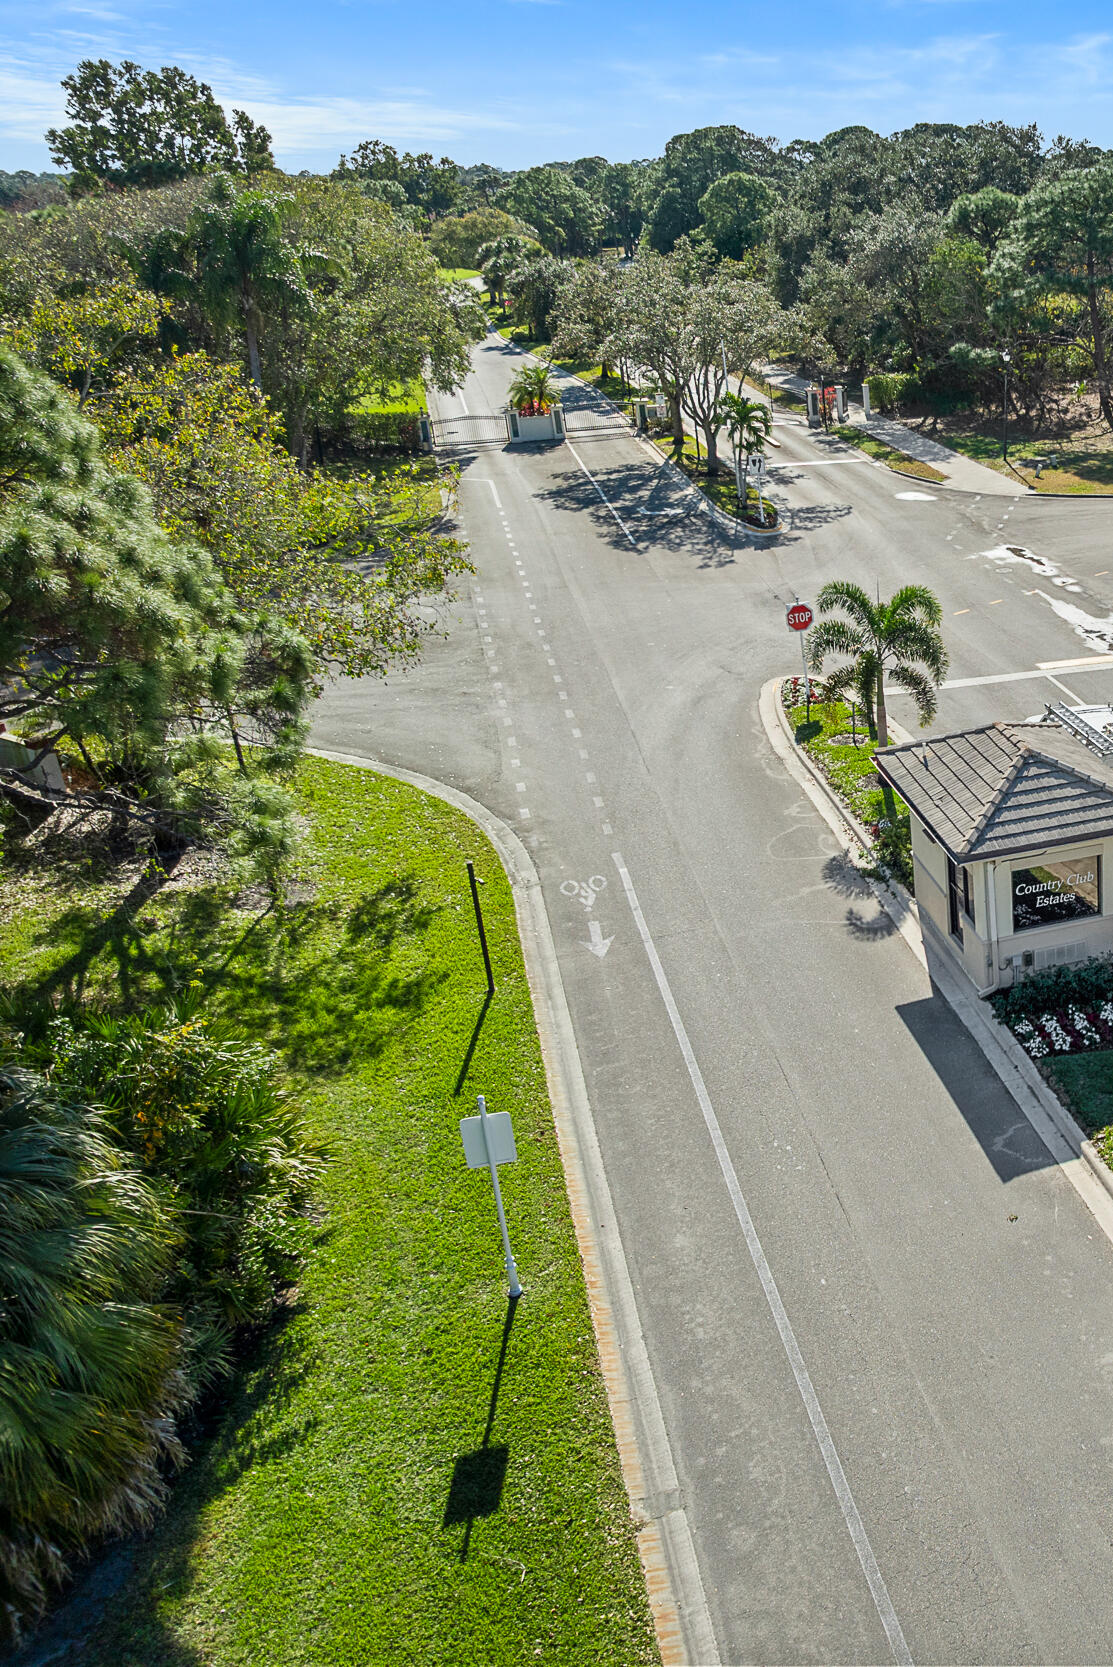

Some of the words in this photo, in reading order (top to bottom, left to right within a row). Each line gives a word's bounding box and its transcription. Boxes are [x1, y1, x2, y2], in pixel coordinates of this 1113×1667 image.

[788, 611, 811, 624] STOP
[1015, 879, 1064, 896] Country
[1066, 872, 1094, 886] Club
[1035, 892, 1076, 908] Estates
